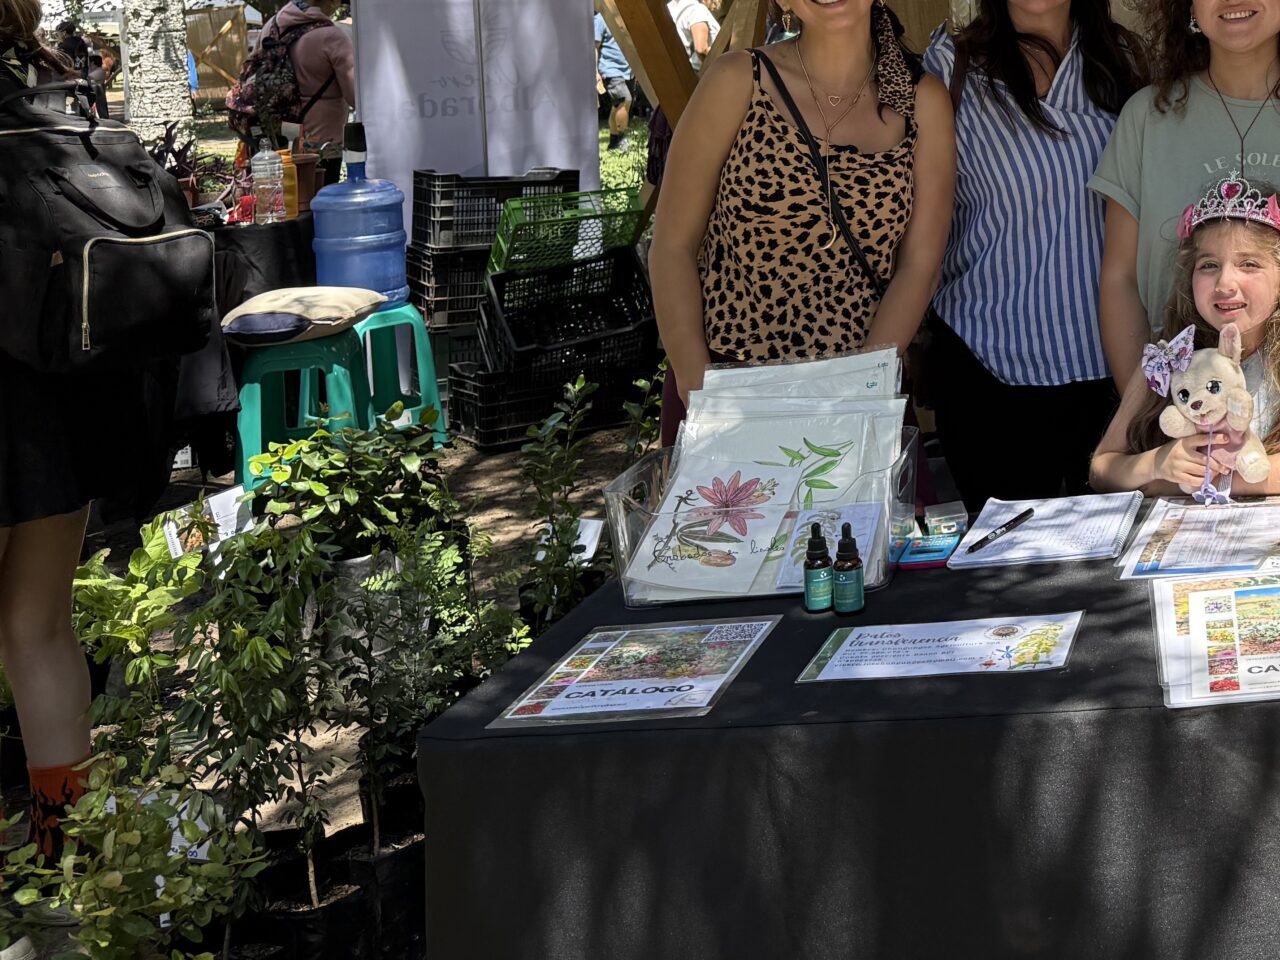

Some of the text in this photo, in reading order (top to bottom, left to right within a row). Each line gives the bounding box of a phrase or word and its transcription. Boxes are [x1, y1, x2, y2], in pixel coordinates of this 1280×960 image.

[1203, 156, 1231, 174] LE
[849, 636, 960, 647] transferencia
[855, 631, 901, 640] Datos
[564, 683, 696, 700] CATÁLOGO
